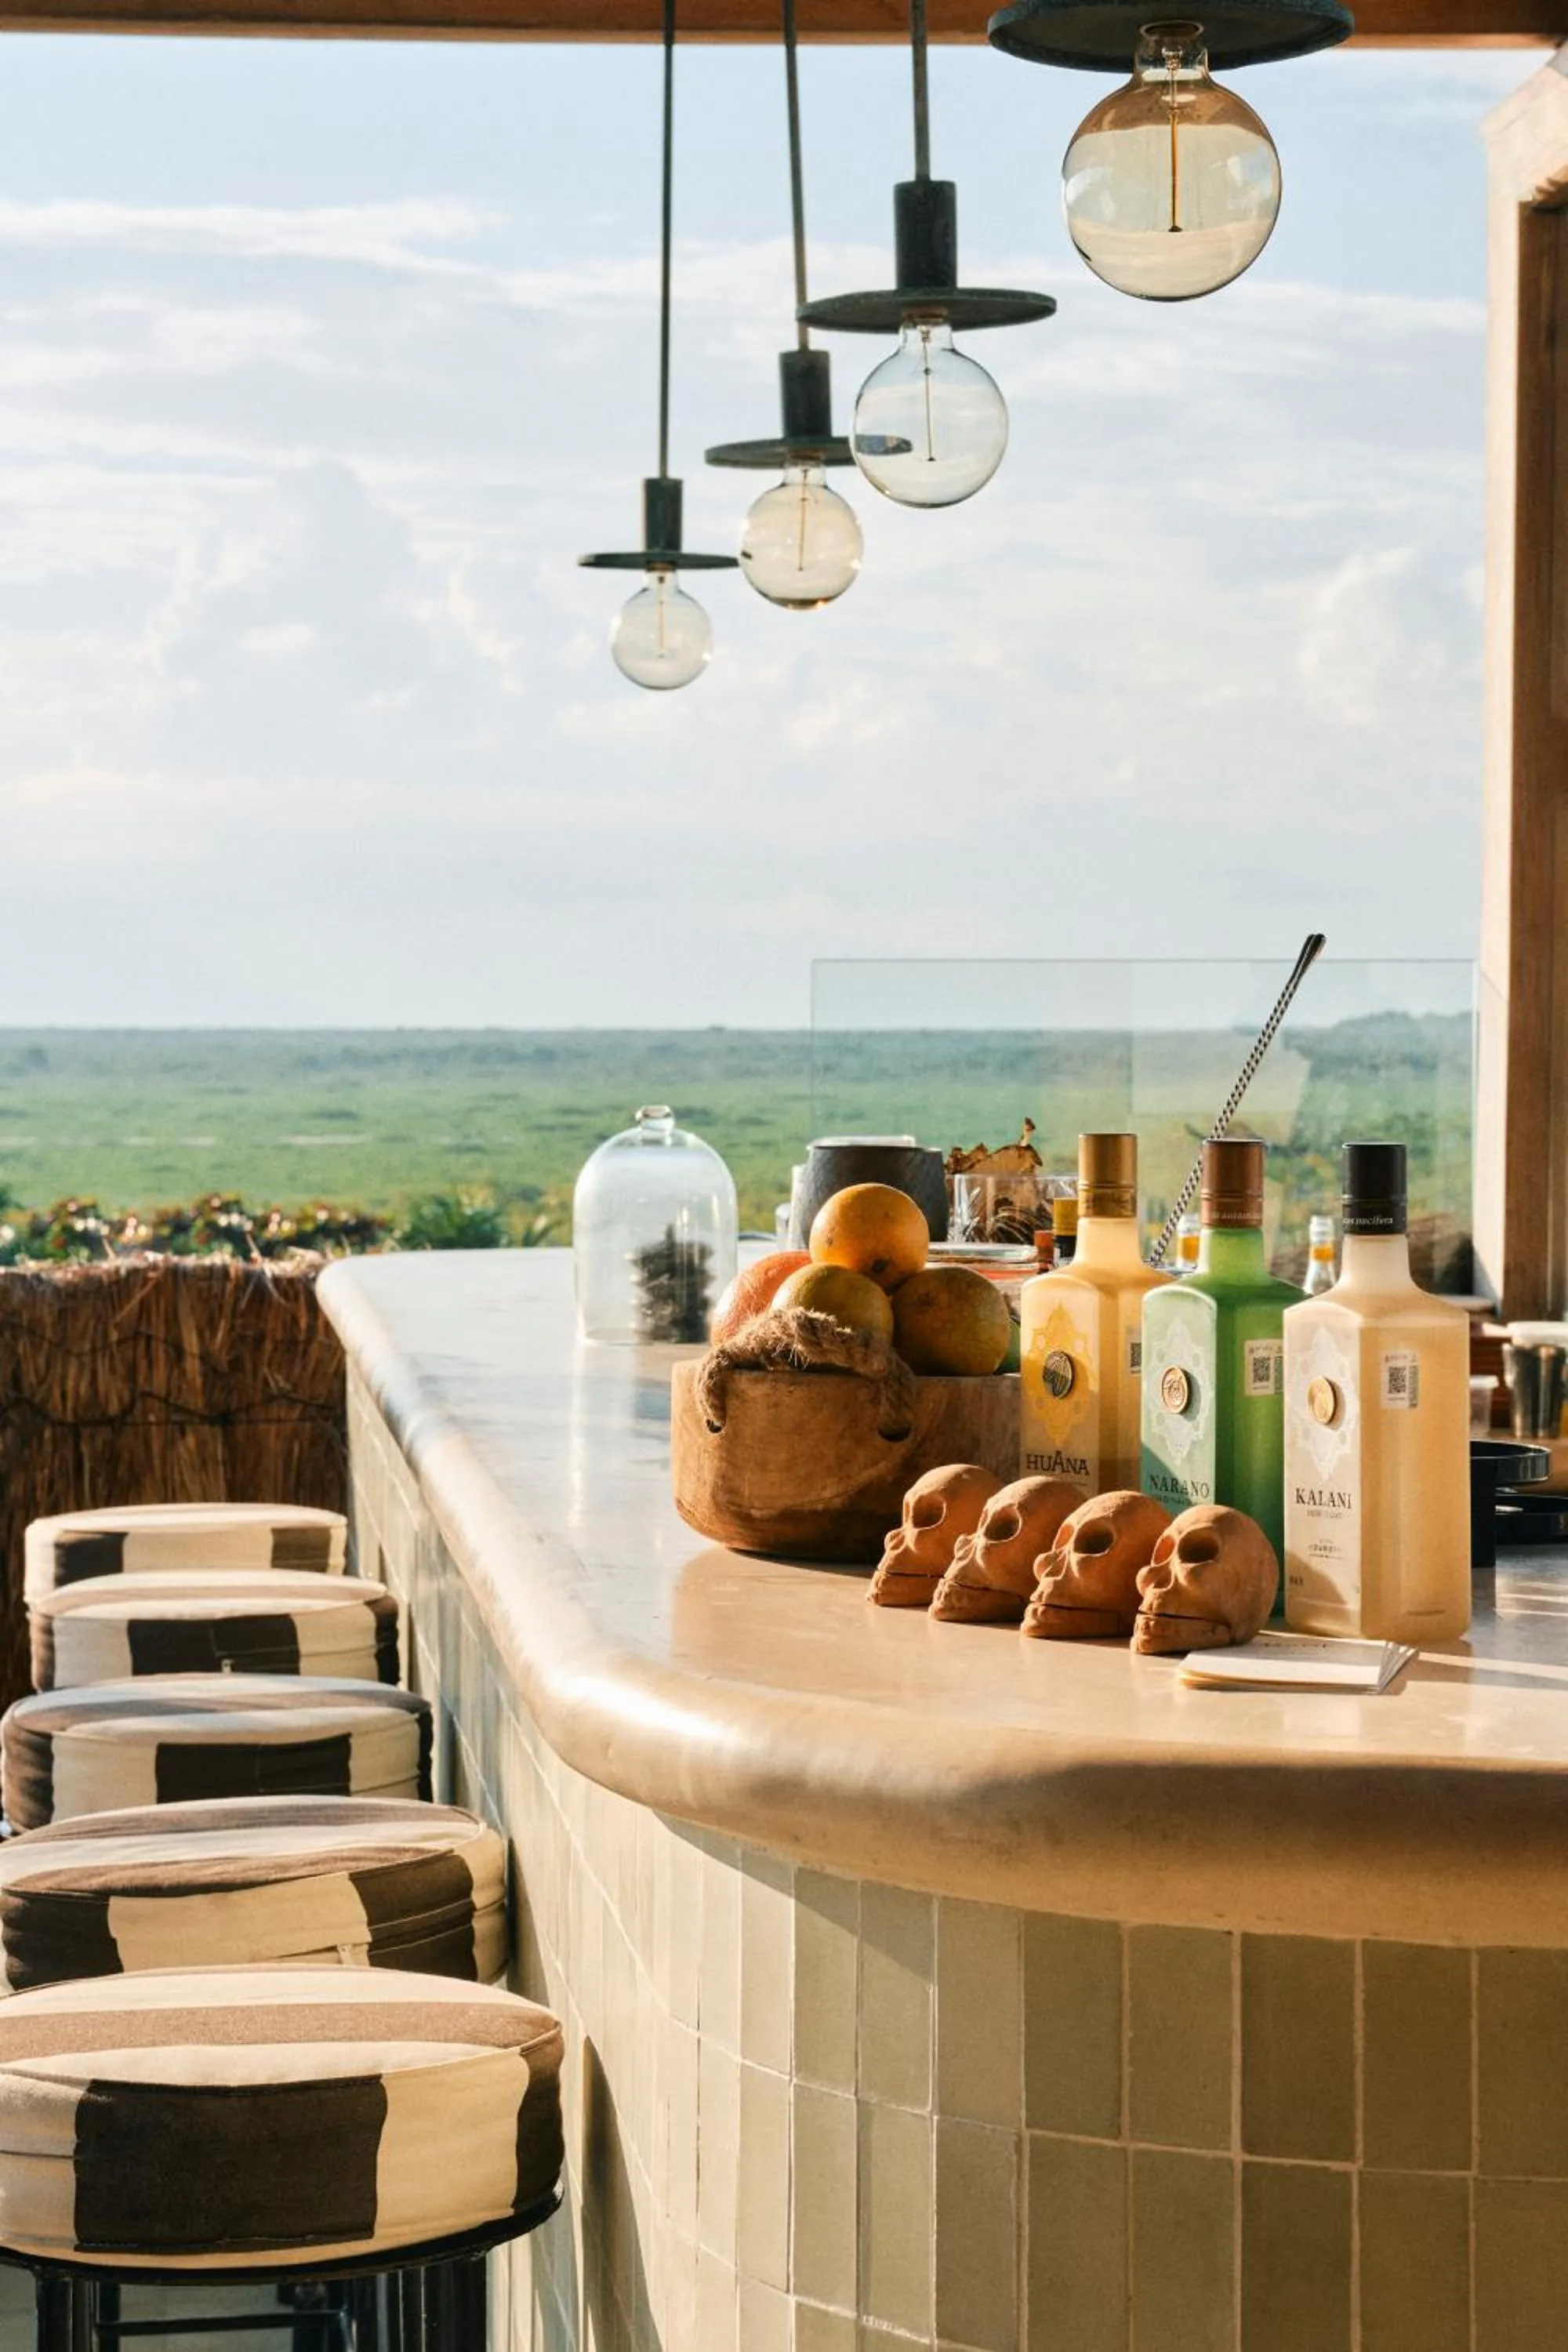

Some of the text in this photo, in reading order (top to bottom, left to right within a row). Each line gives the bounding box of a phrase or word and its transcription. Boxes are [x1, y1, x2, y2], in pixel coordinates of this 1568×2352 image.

[1026, 1450, 1089, 1475] HUANA
[1149, 1475, 1210, 1499] NARANO
[1296, 1487, 1352, 1509] KALANI
